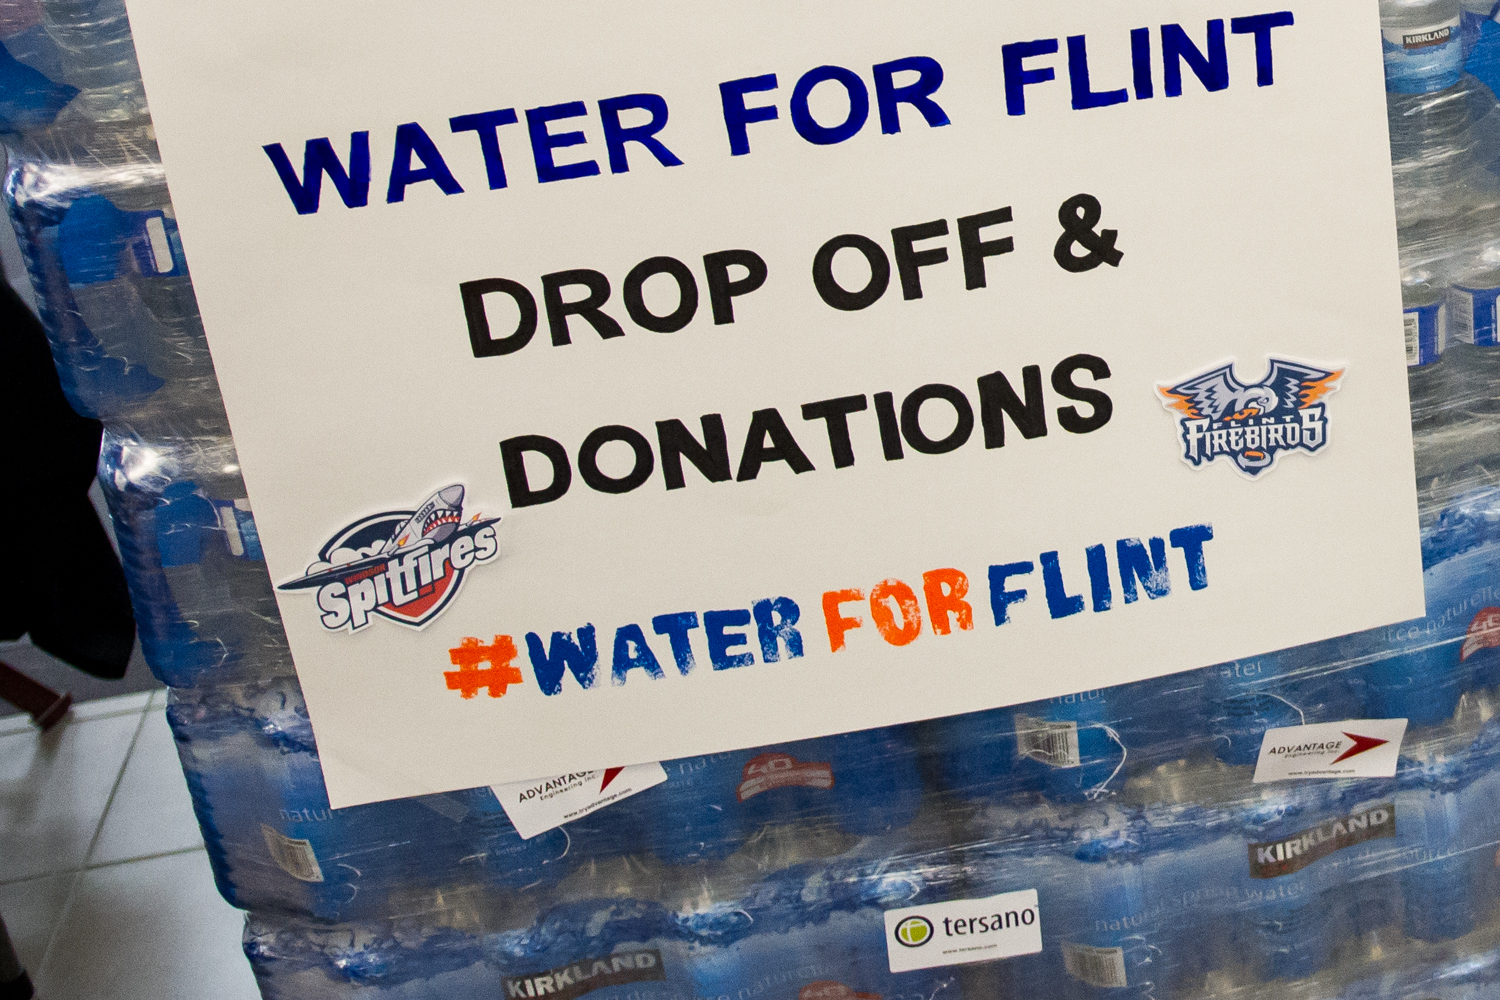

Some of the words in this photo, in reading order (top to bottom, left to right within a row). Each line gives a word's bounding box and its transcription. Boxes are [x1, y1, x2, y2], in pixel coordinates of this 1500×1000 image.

[1405, 28, 1450, 44] KIRKLAND
[262, 94, 685, 216] WATER
[718, 55, 951, 157] FOR
[1001, 11, 1295, 116] FLINT
[459, 249, 768, 358] DROP
[812, 206, 1015, 311] OFF
[1053, 193, 1125, 273] &
[500, 354, 1113, 508] DONATIONS
[1184, 406, 1324, 463] FIREBIRDS
[1212, 414, 1295, 430] FLINT
[317, 525, 498, 630] Spitfires
[345, 563, 387, 585] WINDSOR
[1268, 740, 1343, 755] ADVANTAGE
[539, 780, 583, 801] Engineering
[563, 787, 633, 819] www.tryadvantage.com
[1254, 807, 1391, 864] KIRKLAND
[942, 907, 1035, 937] tersano
[507, 952, 657, 999] KIRKLAND
